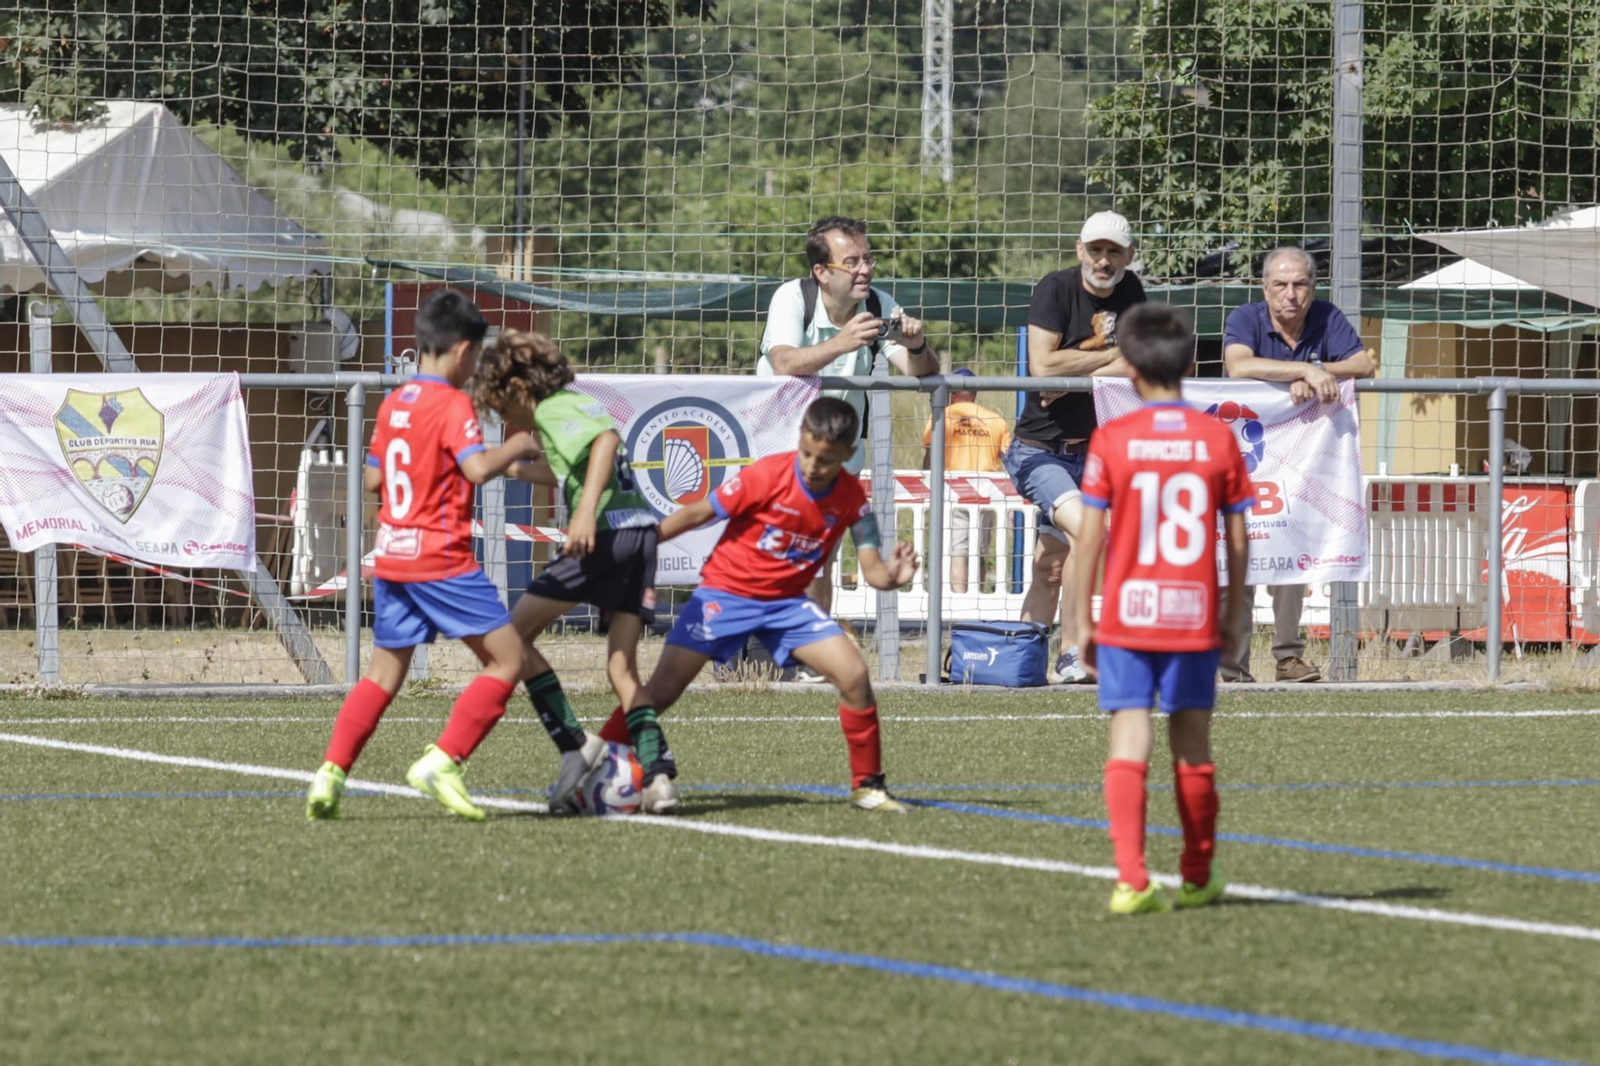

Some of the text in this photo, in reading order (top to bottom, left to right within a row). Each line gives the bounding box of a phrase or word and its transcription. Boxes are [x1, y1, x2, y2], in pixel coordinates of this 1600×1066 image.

[69, 437, 157, 447] CLUB DEPORTIVO RUA
[682, 410, 732, 442] ACADEMY
[386, 438, 412, 519] 6
[1131, 471, 1208, 566] 18
[15, 517, 87, 540] MEMORIAL
[136, 541, 179, 556] SEARA
[656, 556, 698, 572] IGUEL
[1250, 557, 1294, 571] SEARA
